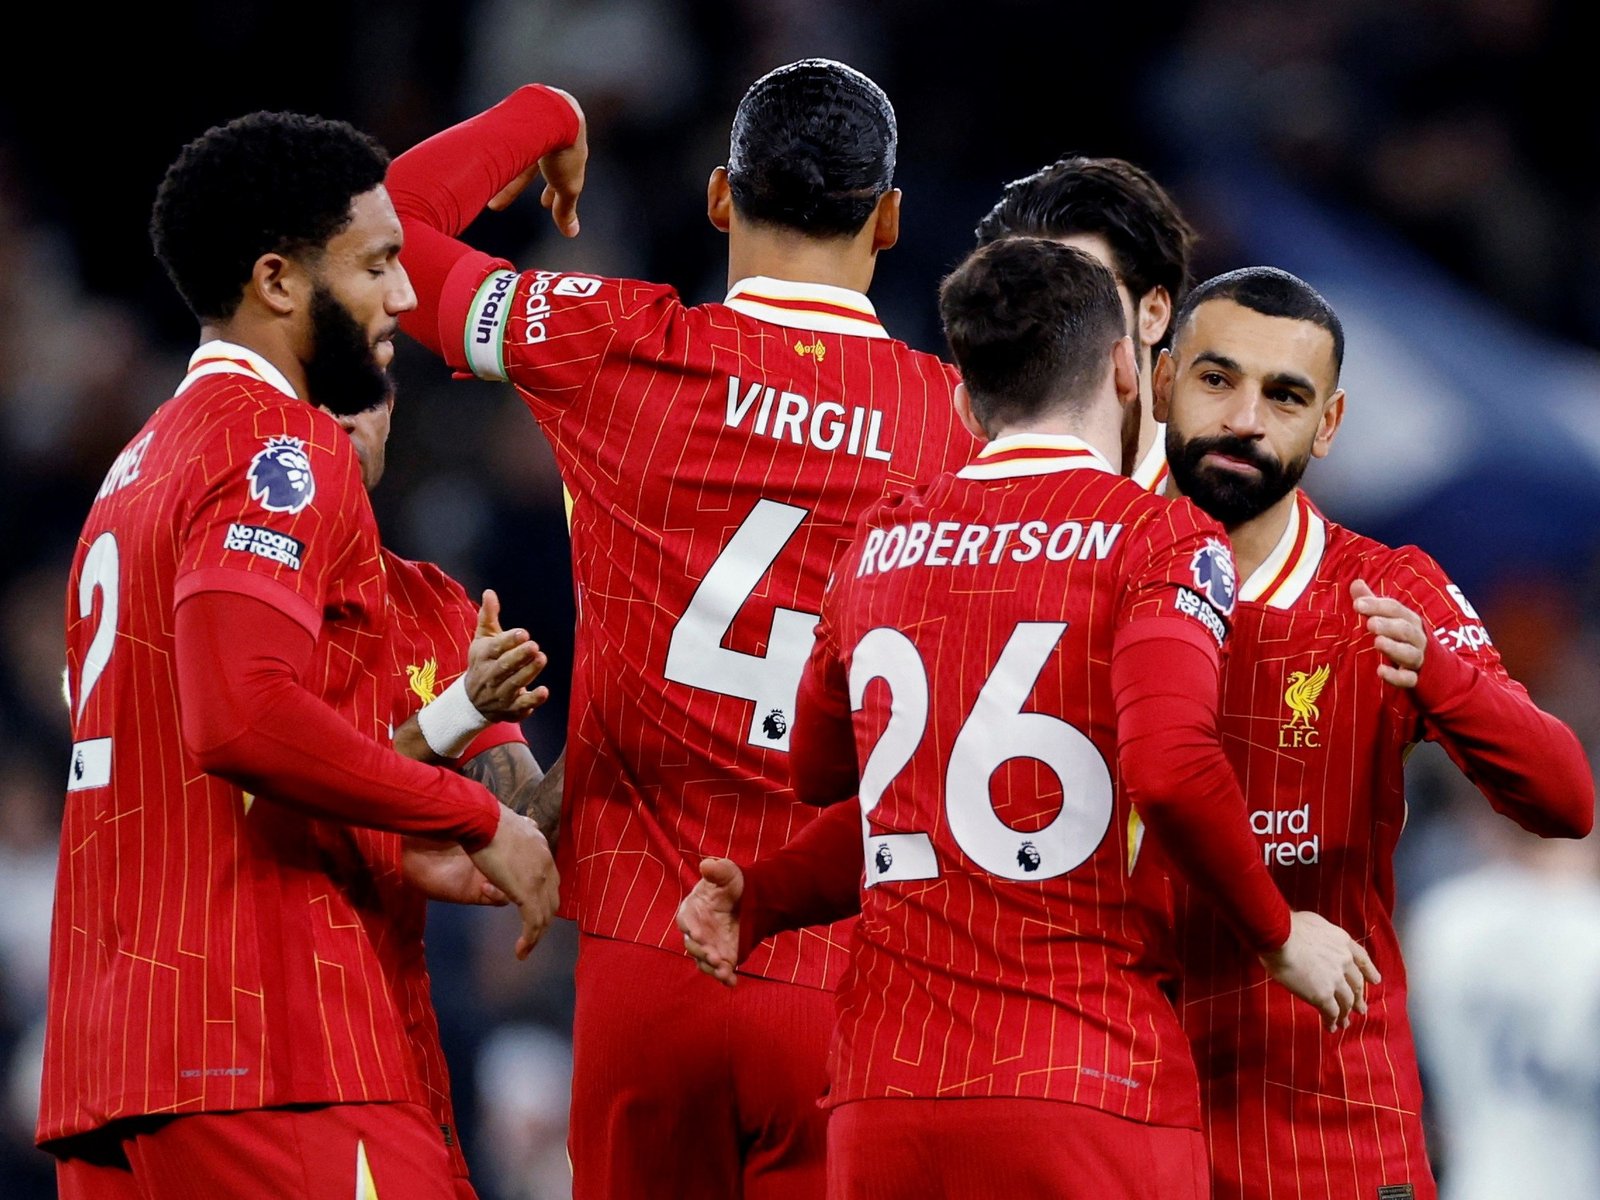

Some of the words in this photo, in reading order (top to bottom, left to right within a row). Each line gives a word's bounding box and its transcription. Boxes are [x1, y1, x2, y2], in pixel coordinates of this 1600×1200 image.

[725, 375, 892, 462] VIRGIL
[94, 430, 155, 504] OMEZ
[223, 536, 250, 551] for
[227, 523, 254, 540] No
[253, 528, 299, 556] room
[856, 520, 1123, 579] ROBERTSON
[1174, 598, 1199, 617] for
[1177, 587, 1201, 608] No
[663, 497, 822, 752] 4
[67, 530, 120, 792] 2
[848, 620, 1115, 890] 26
[1278, 730, 1322, 748] L.F.C.
[1249, 803, 1309, 835] ard
[1264, 834, 1319, 866] red
